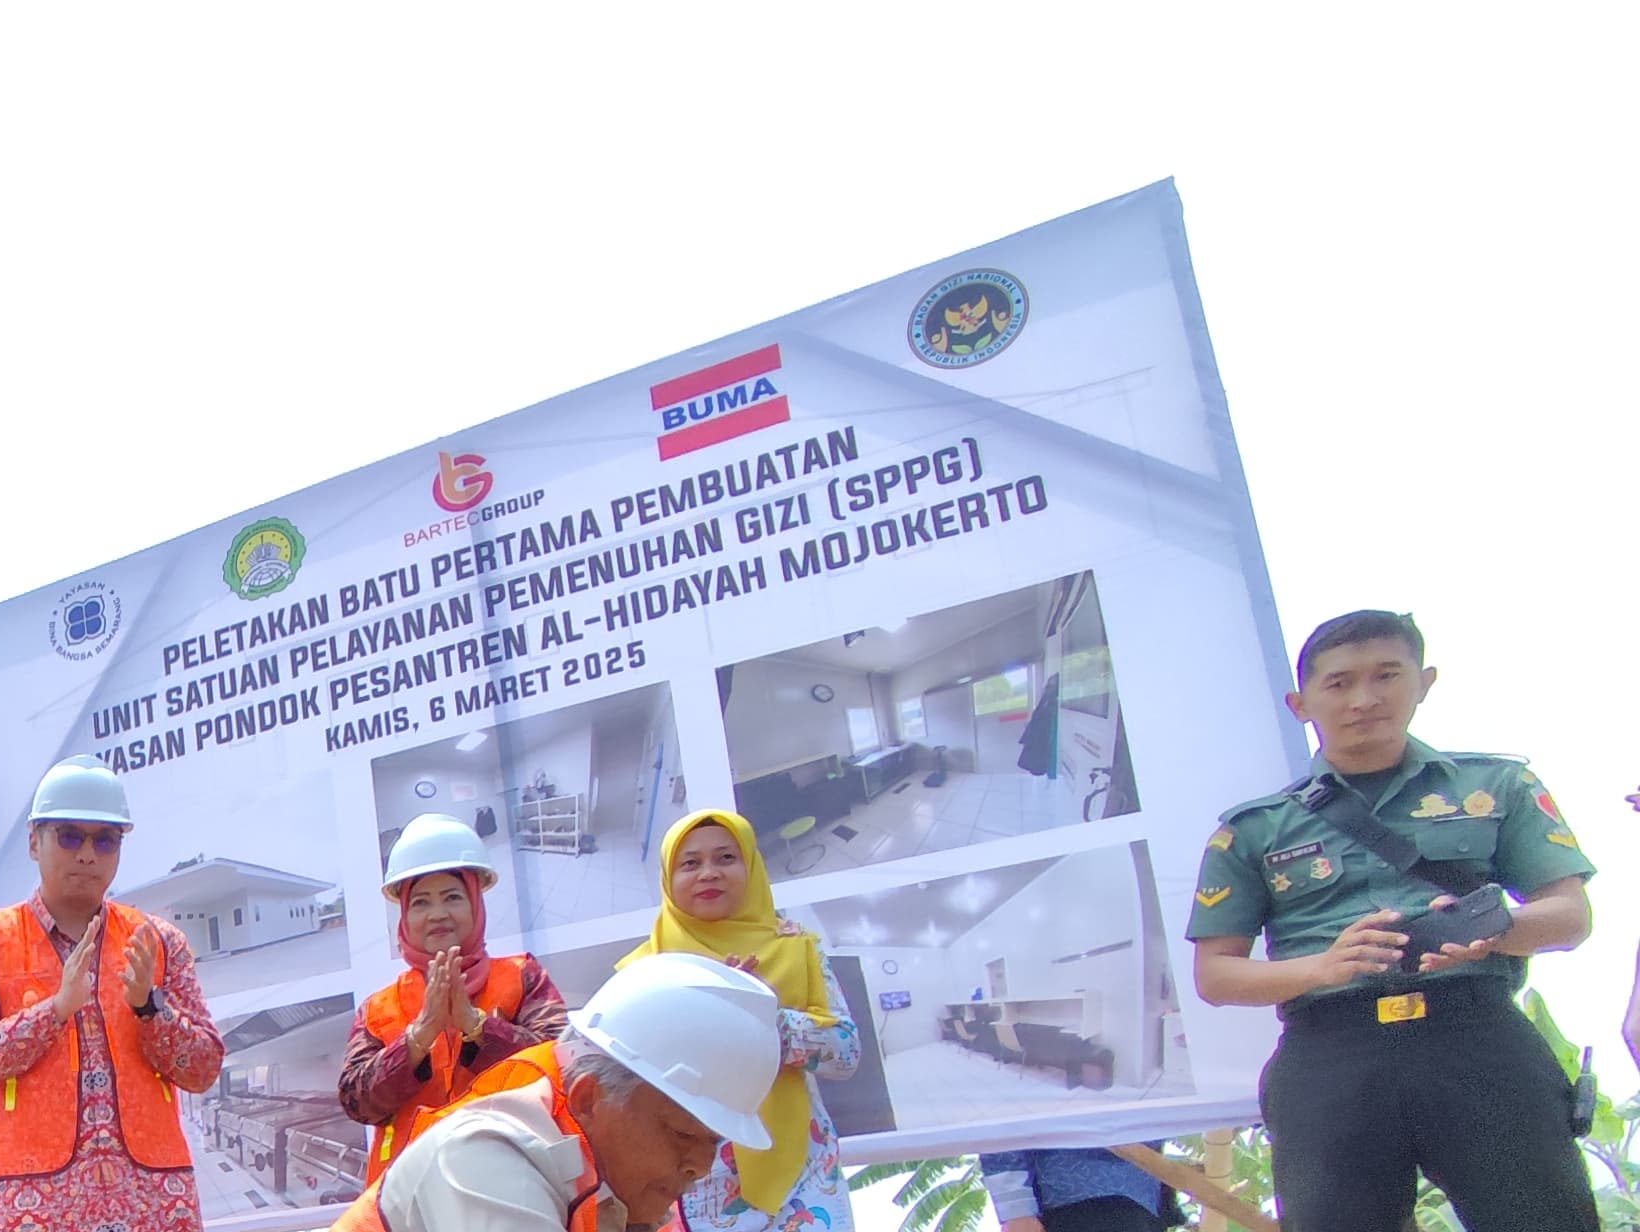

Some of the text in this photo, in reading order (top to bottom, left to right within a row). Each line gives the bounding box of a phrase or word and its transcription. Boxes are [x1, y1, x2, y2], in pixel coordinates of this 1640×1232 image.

[967, 273, 1017, 294] NASIONAL
[919, 312, 1022, 365] REPUBLIK INDONESIA
[662, 377, 778, 431] BUMA
[93, 437, 983, 740] UNIT SATUAN PELAYANAN PEMENUHAN GIZI (SPPG)
[163, 425, 859, 676] PELETAKAN BATU PERTAMA PEMBUATAN
[59, 581, 106, 604] YAYASAN
[195, 685, 321, 751] PONDOK
[329, 624, 529, 711] PESANTREN
[541, 556, 767, 650] AL-HIDAYAH
[779, 475, 1048, 582] MOJOKERTO
[325, 640, 647, 752] KAMIS, 6 MARET 2025
